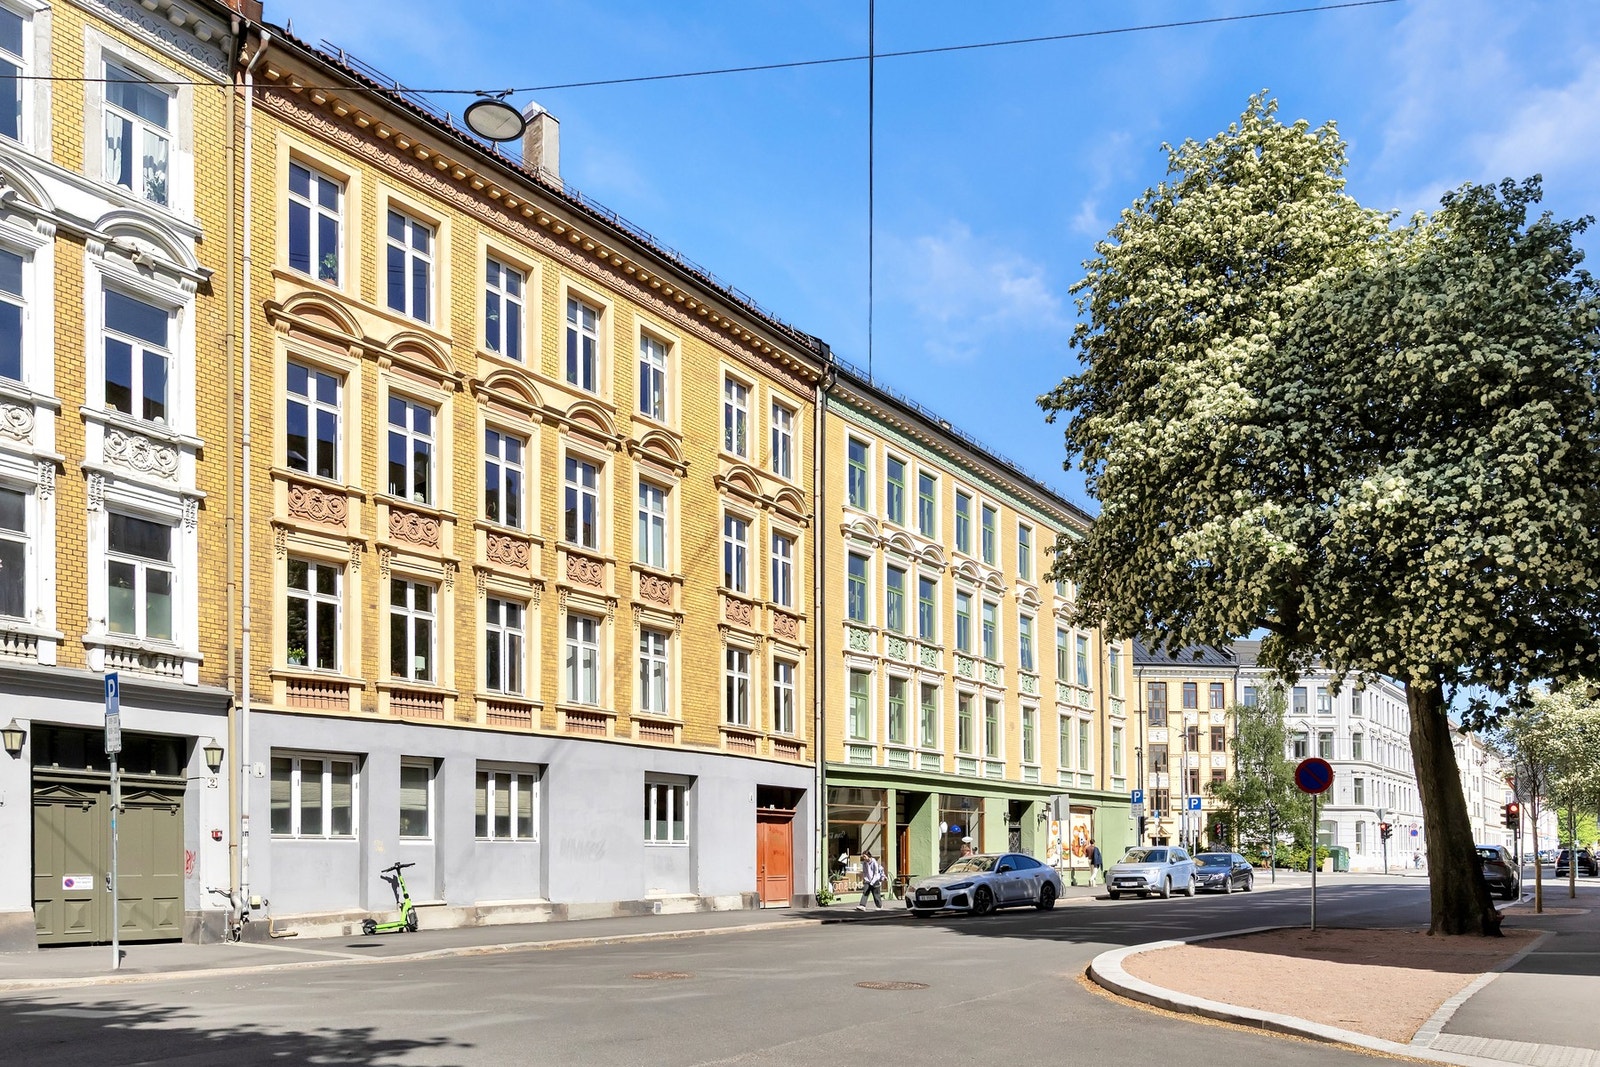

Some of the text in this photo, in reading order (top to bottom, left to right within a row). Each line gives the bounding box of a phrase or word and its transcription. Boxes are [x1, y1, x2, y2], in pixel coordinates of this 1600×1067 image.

[108, 679, 115, 709] P
[1134, 791, 1140, 802] P
[1191, 799, 1198, 808] P
